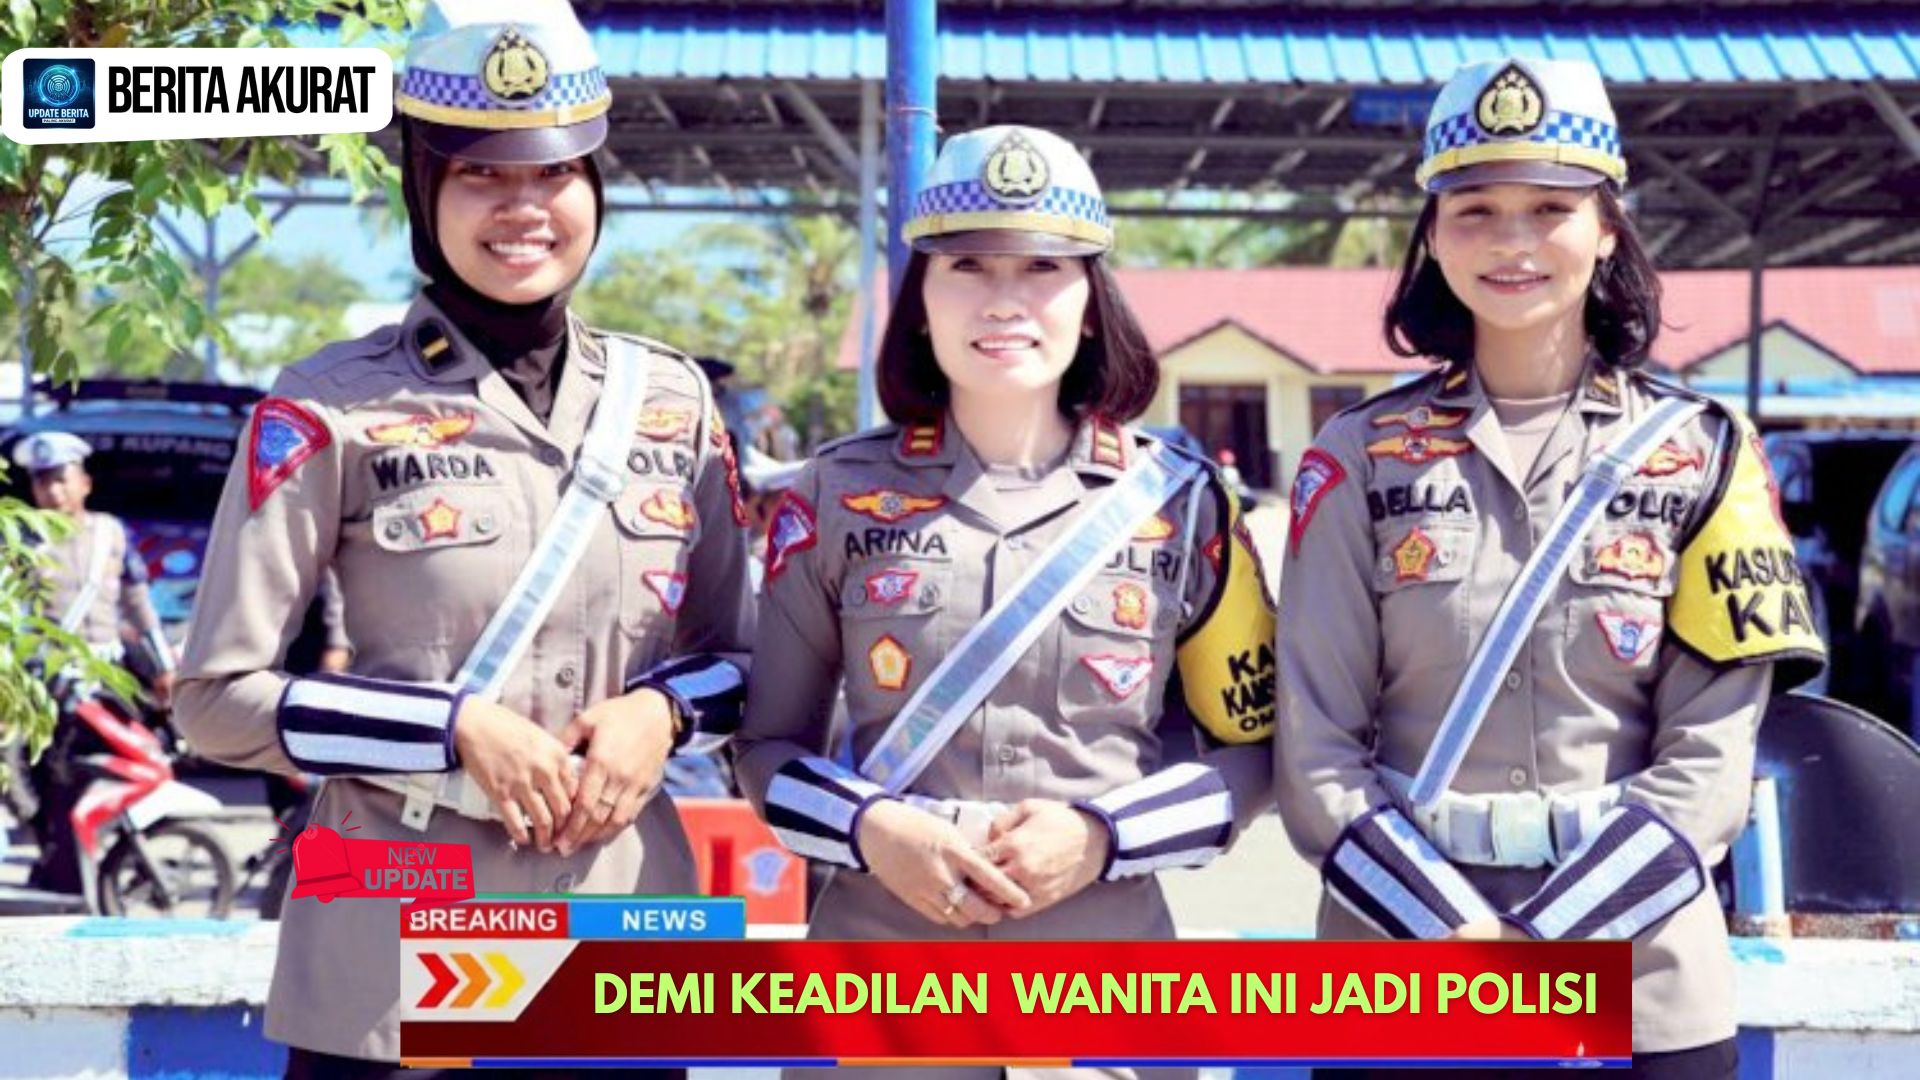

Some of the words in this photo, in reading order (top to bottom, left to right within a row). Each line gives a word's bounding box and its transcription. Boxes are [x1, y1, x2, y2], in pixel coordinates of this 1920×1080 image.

[371, 453, 495, 491] WARDA
[1367, 484, 1472, 521] BELLA
[1605, 488, 1699, 531] OLRI
[844, 527, 947, 560] ARINA
[1727, 590, 1814, 643] KA
